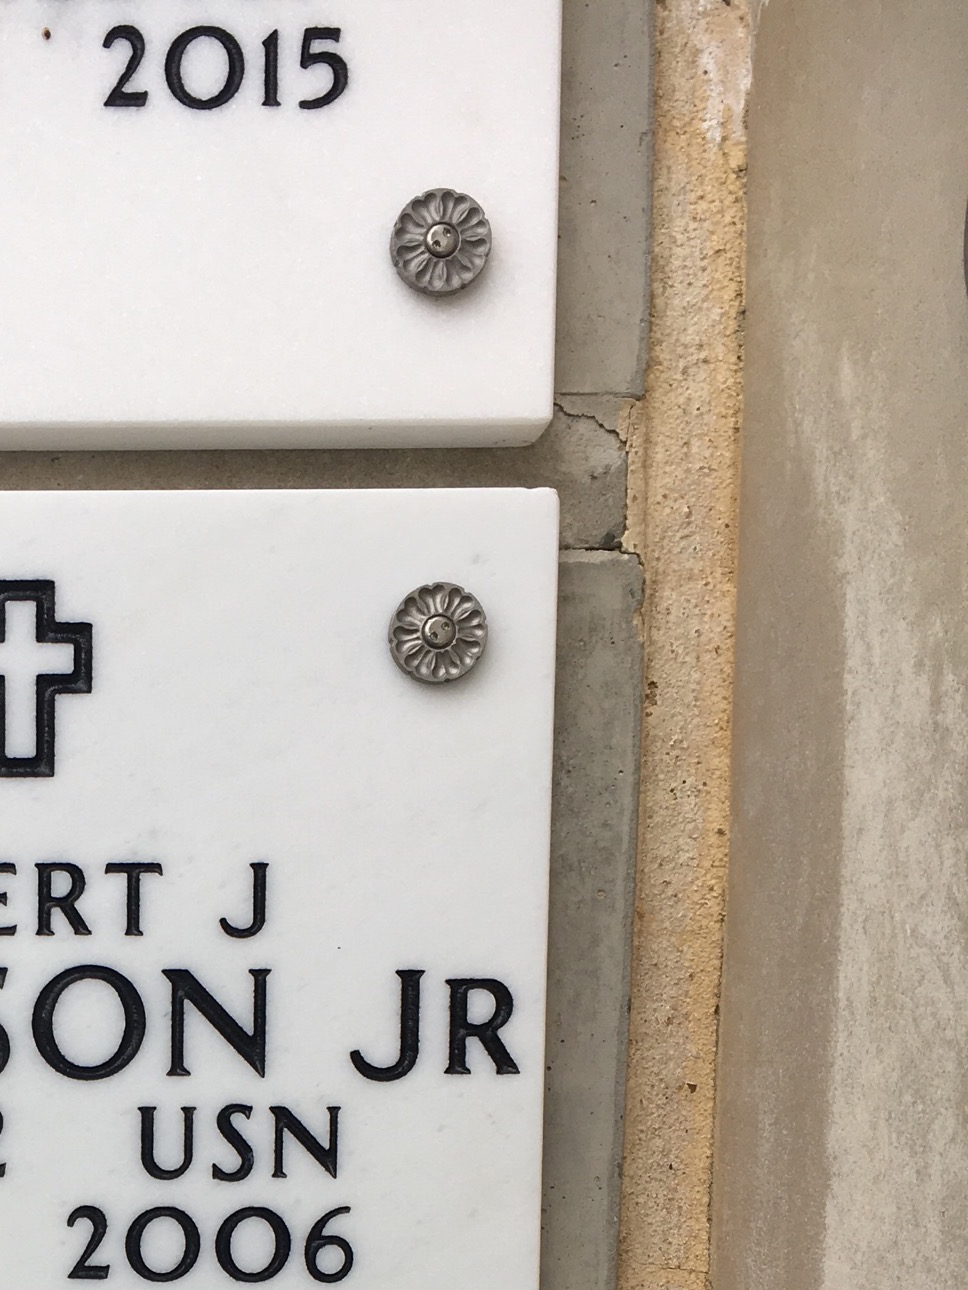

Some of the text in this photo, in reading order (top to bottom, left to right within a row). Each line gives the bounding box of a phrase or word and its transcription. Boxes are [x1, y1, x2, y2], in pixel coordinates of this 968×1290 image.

[101, 24, 349, 111] 2015
[218, 861, 271, 939] J
[348, 967, 521, 1084] JR
[136, 1102, 342, 1183] USN
[65, 1204, 355, 1285] 2006
